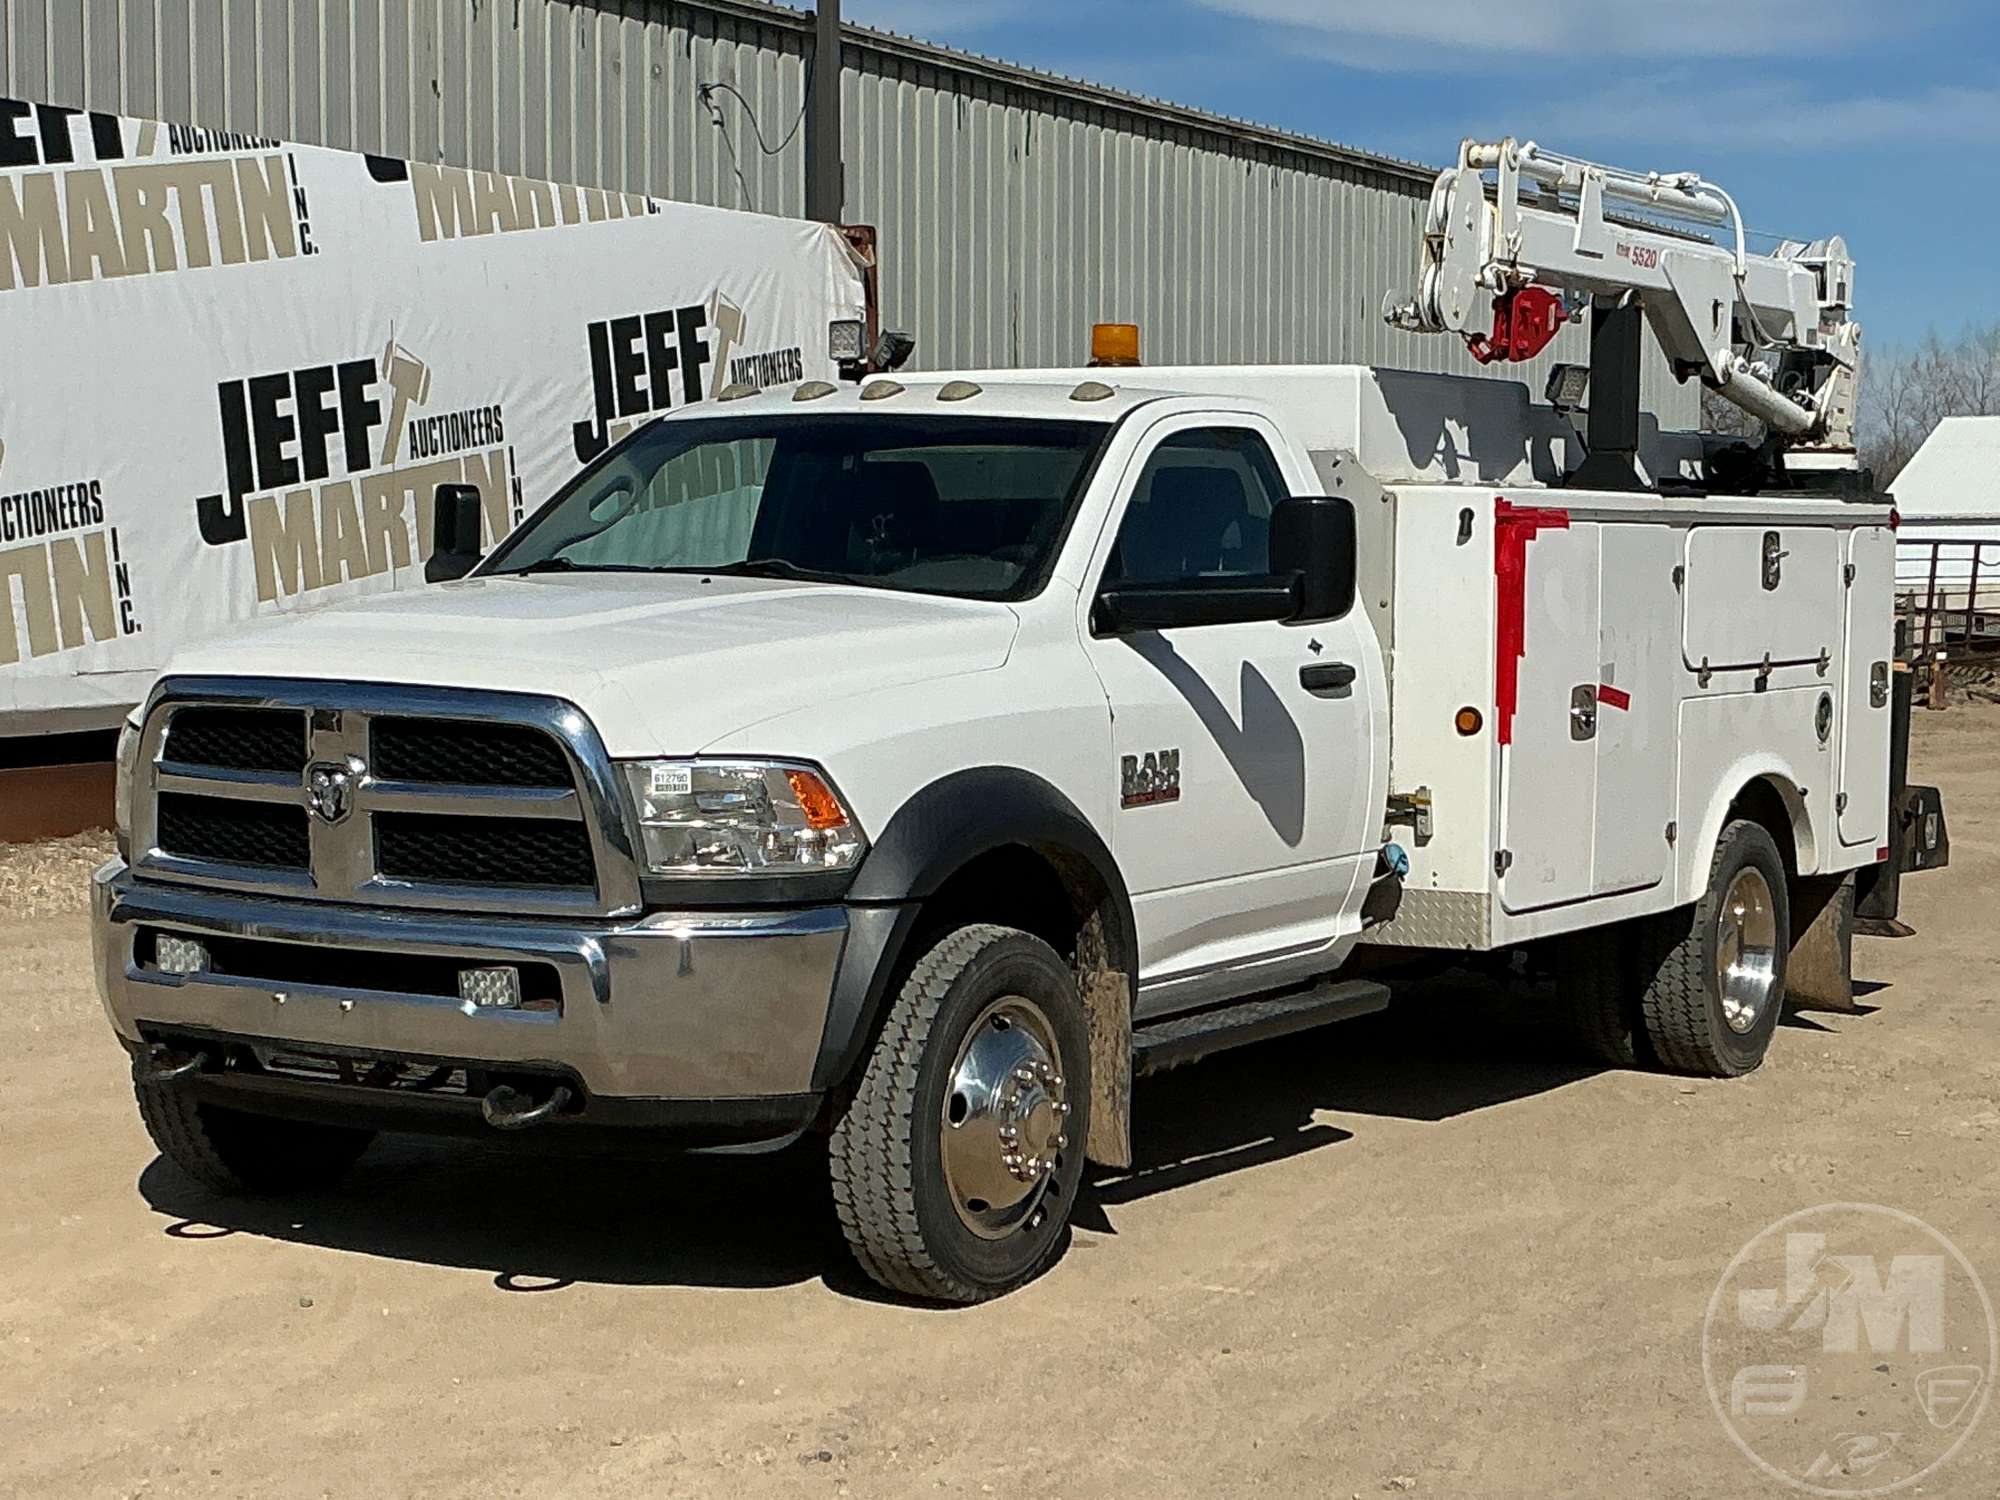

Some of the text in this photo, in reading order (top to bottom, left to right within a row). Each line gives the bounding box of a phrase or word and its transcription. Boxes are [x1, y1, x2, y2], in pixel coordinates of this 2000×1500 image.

[0, 155, 298, 290] MARTIN
[1631, 246, 1657, 269] 5520
[196, 358, 382, 545] JEFF
[408, 404, 504, 460] AUCTIONEERS
[572, 304, 710, 465] JEFF
[250, 448, 511, 602] MARTN
